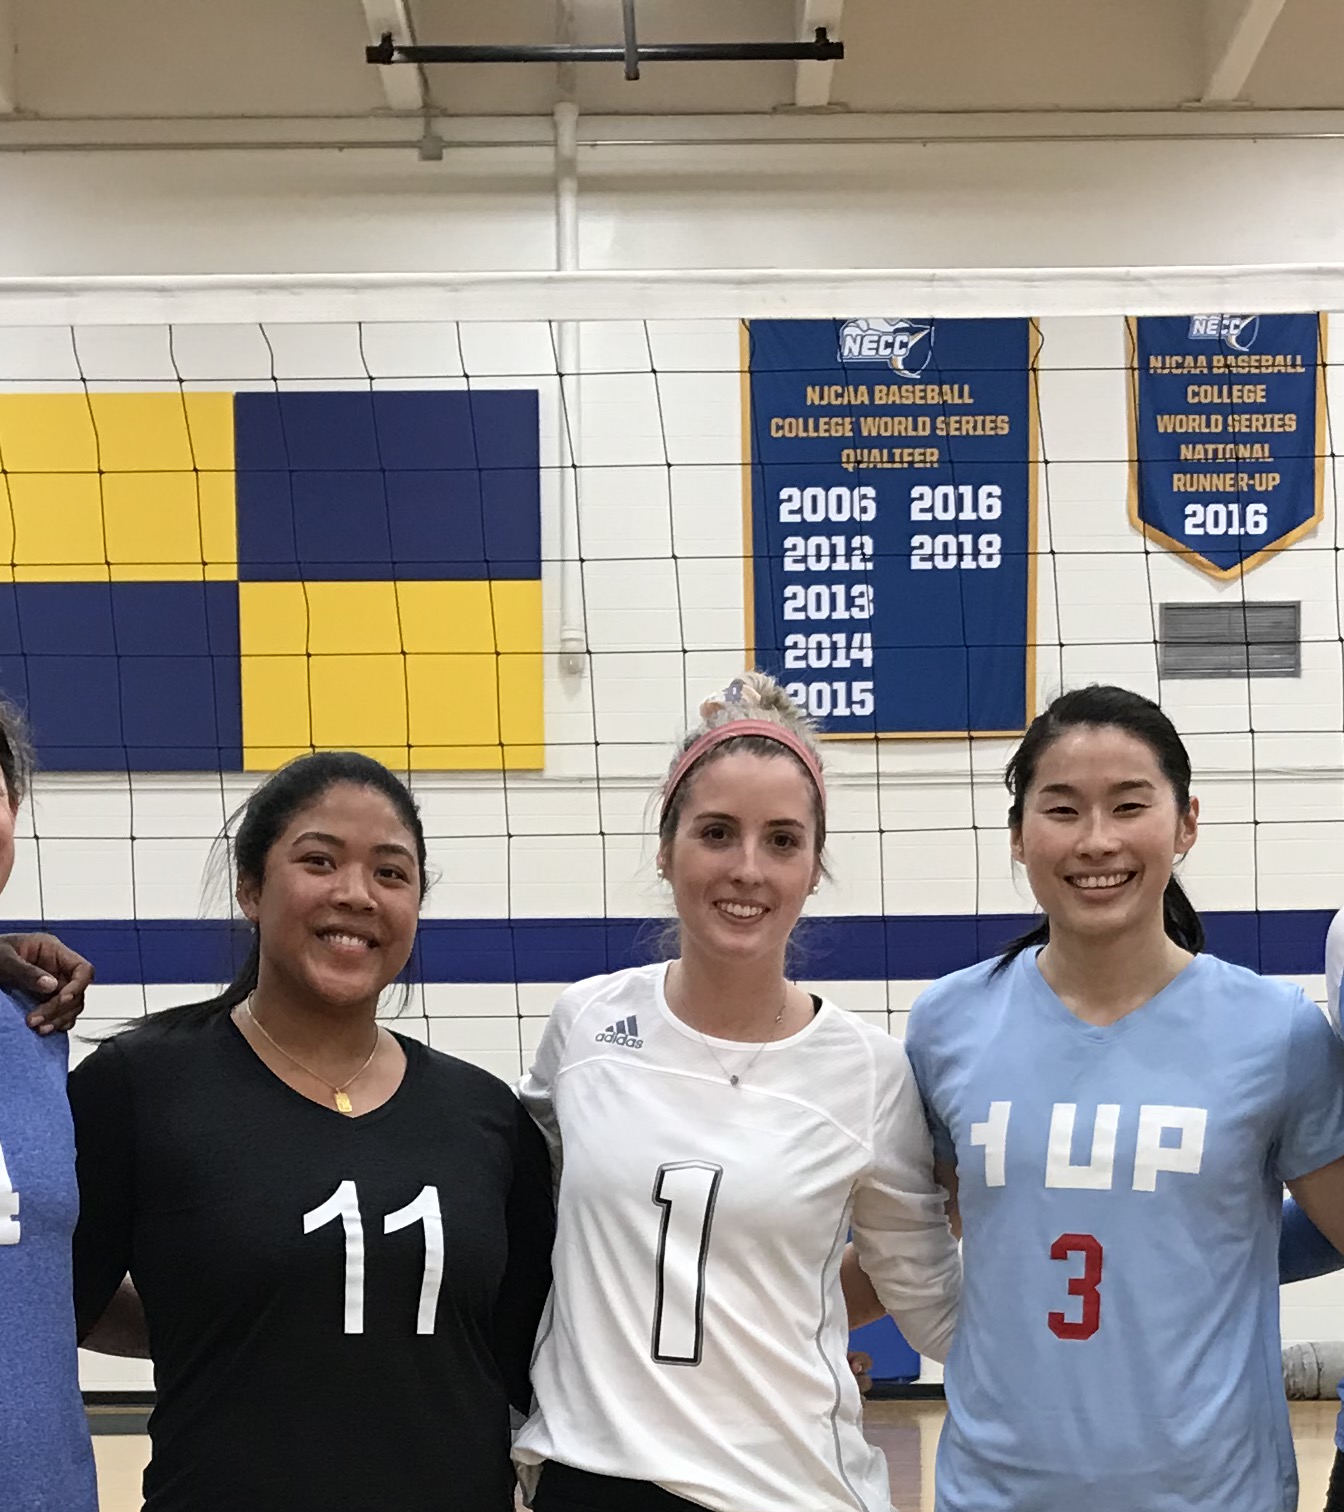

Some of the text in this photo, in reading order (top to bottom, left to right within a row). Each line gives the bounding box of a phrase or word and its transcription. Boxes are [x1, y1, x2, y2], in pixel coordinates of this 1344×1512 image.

[1192, 317, 1241, 336] NECC
[842, 334, 910, 357] NECC
[1149, 354, 1306, 374] NJCAA BASEBALL
[806, 384, 974, 406] NJCAA BASEBALL
[1187, 384, 1266, 403] COLLEGE
[770, 415, 1010, 438] COLLEGE WORLD SERIES
[1157, 413, 1297, 433] WORLD SERIES
[1180, 443, 1274, 463] NATIONAL
[1172, 472, 1281, 492] RUNNER-UP
[779, 484, 1001, 523] 2006 2016
[1184, 503, 1268, 535] 2016
[783, 533, 1001, 571] 2012 2018
[783, 584, 874, 620] 2013
[784, 633, 873, 668] 2014
[786, 681, 875, 717] 2015
[595, 1031, 644, 1049] adidas
[970, 1100, 1208, 1192] 1 UP
[303, 1179, 444, 1335] 11
[652, 1159, 723, 1367] 1
[1047, 1233, 1103, 1341] 3
